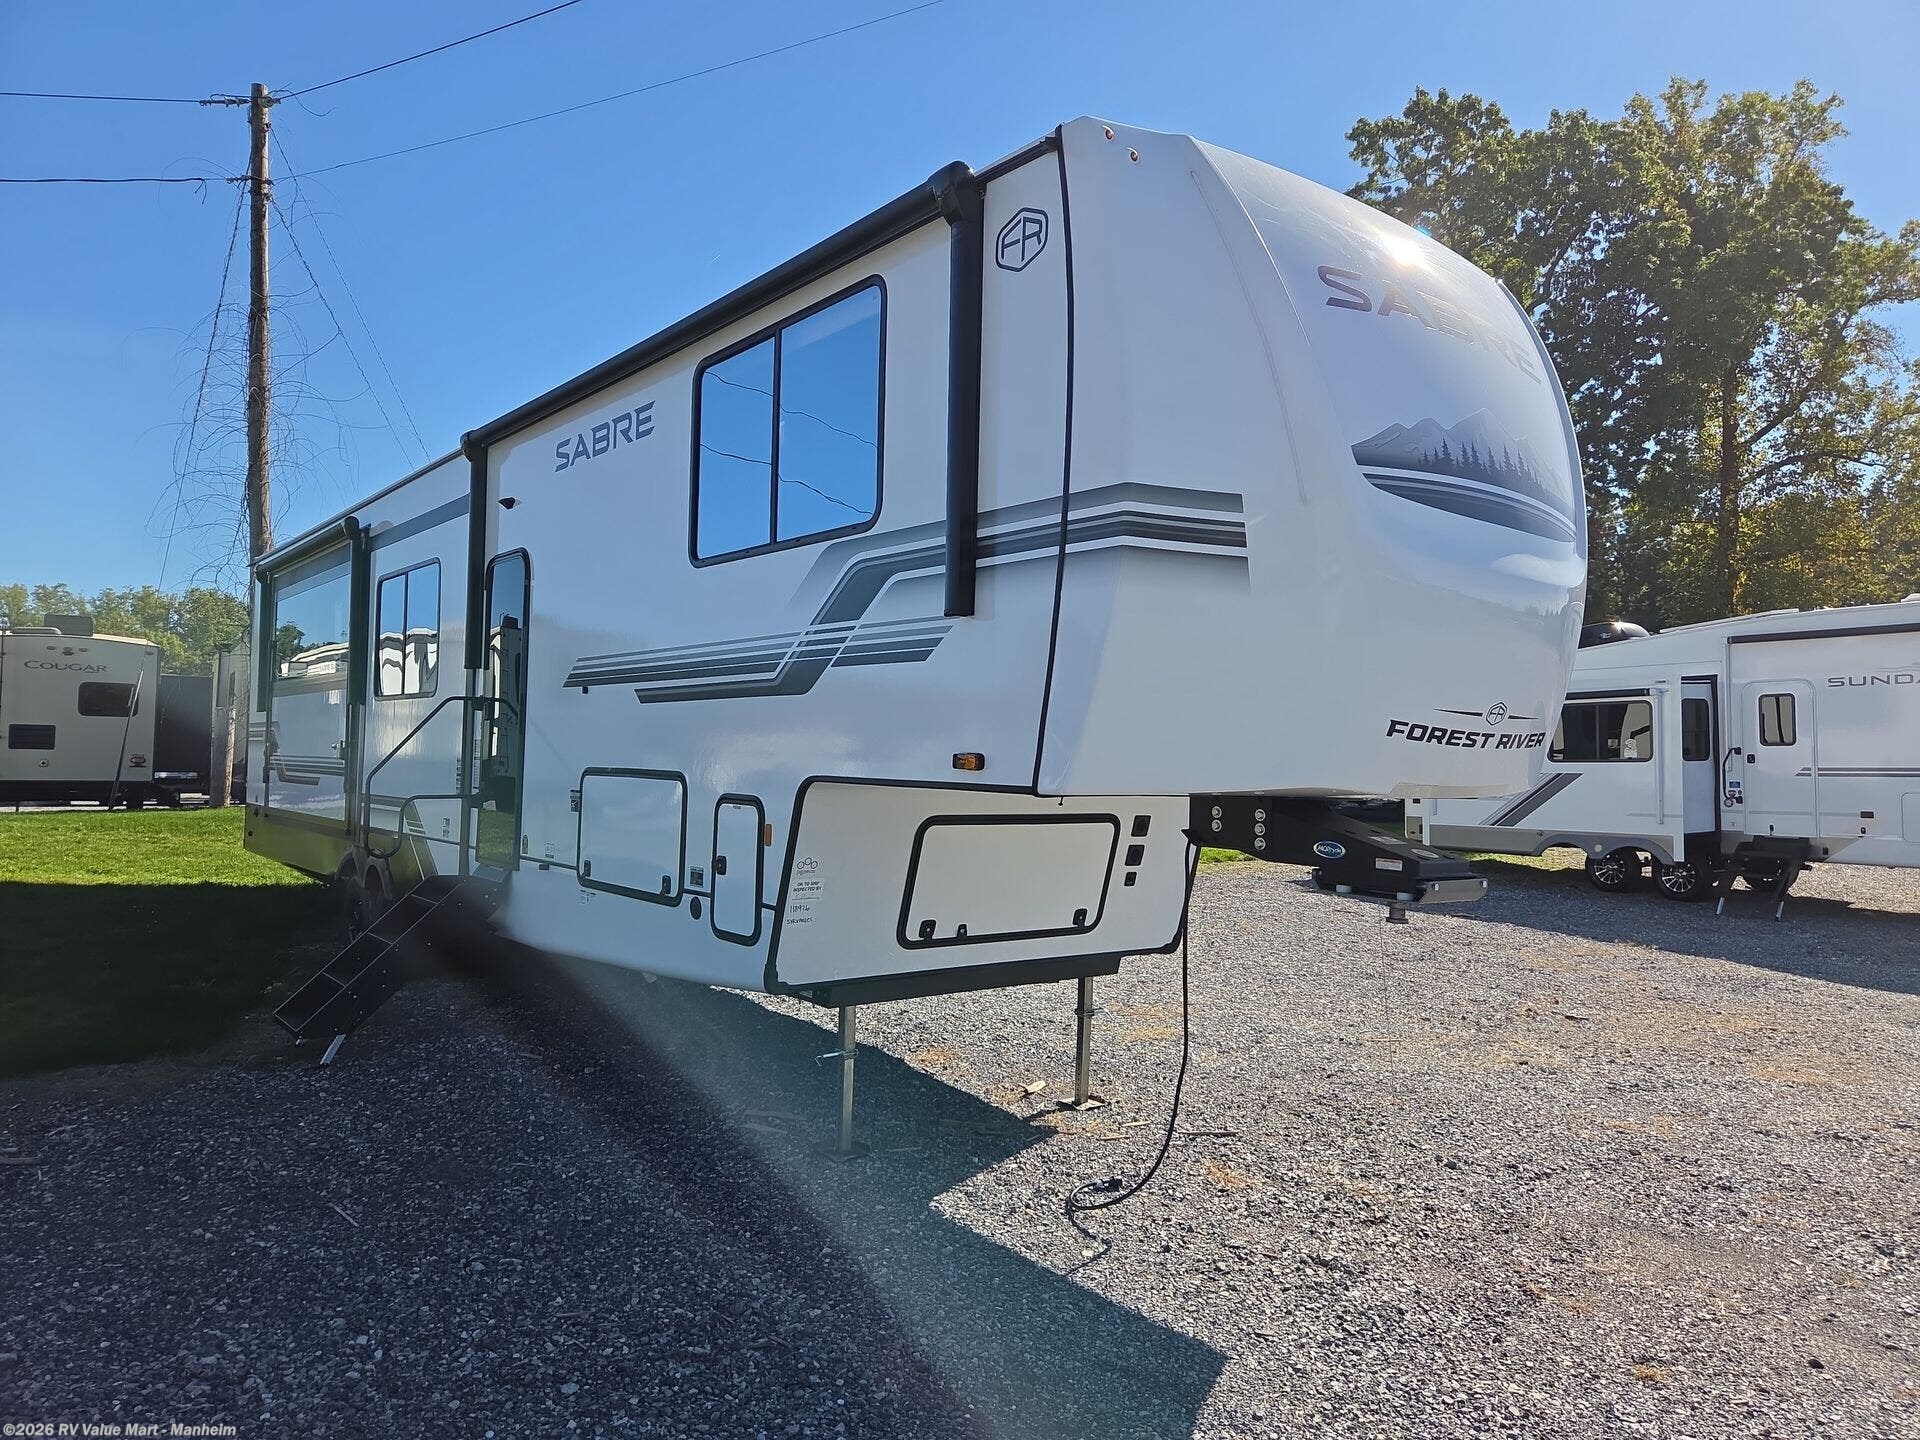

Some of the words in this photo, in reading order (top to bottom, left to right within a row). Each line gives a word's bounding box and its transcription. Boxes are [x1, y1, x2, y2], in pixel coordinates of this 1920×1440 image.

[555, 400, 656, 472] SABRE
[24, 660, 109, 673] COUGAR
[1827, 674, 1920, 687] SUND
[1386, 719, 1495, 749] FOREST
[1495, 732, 1547, 750] RIVER
